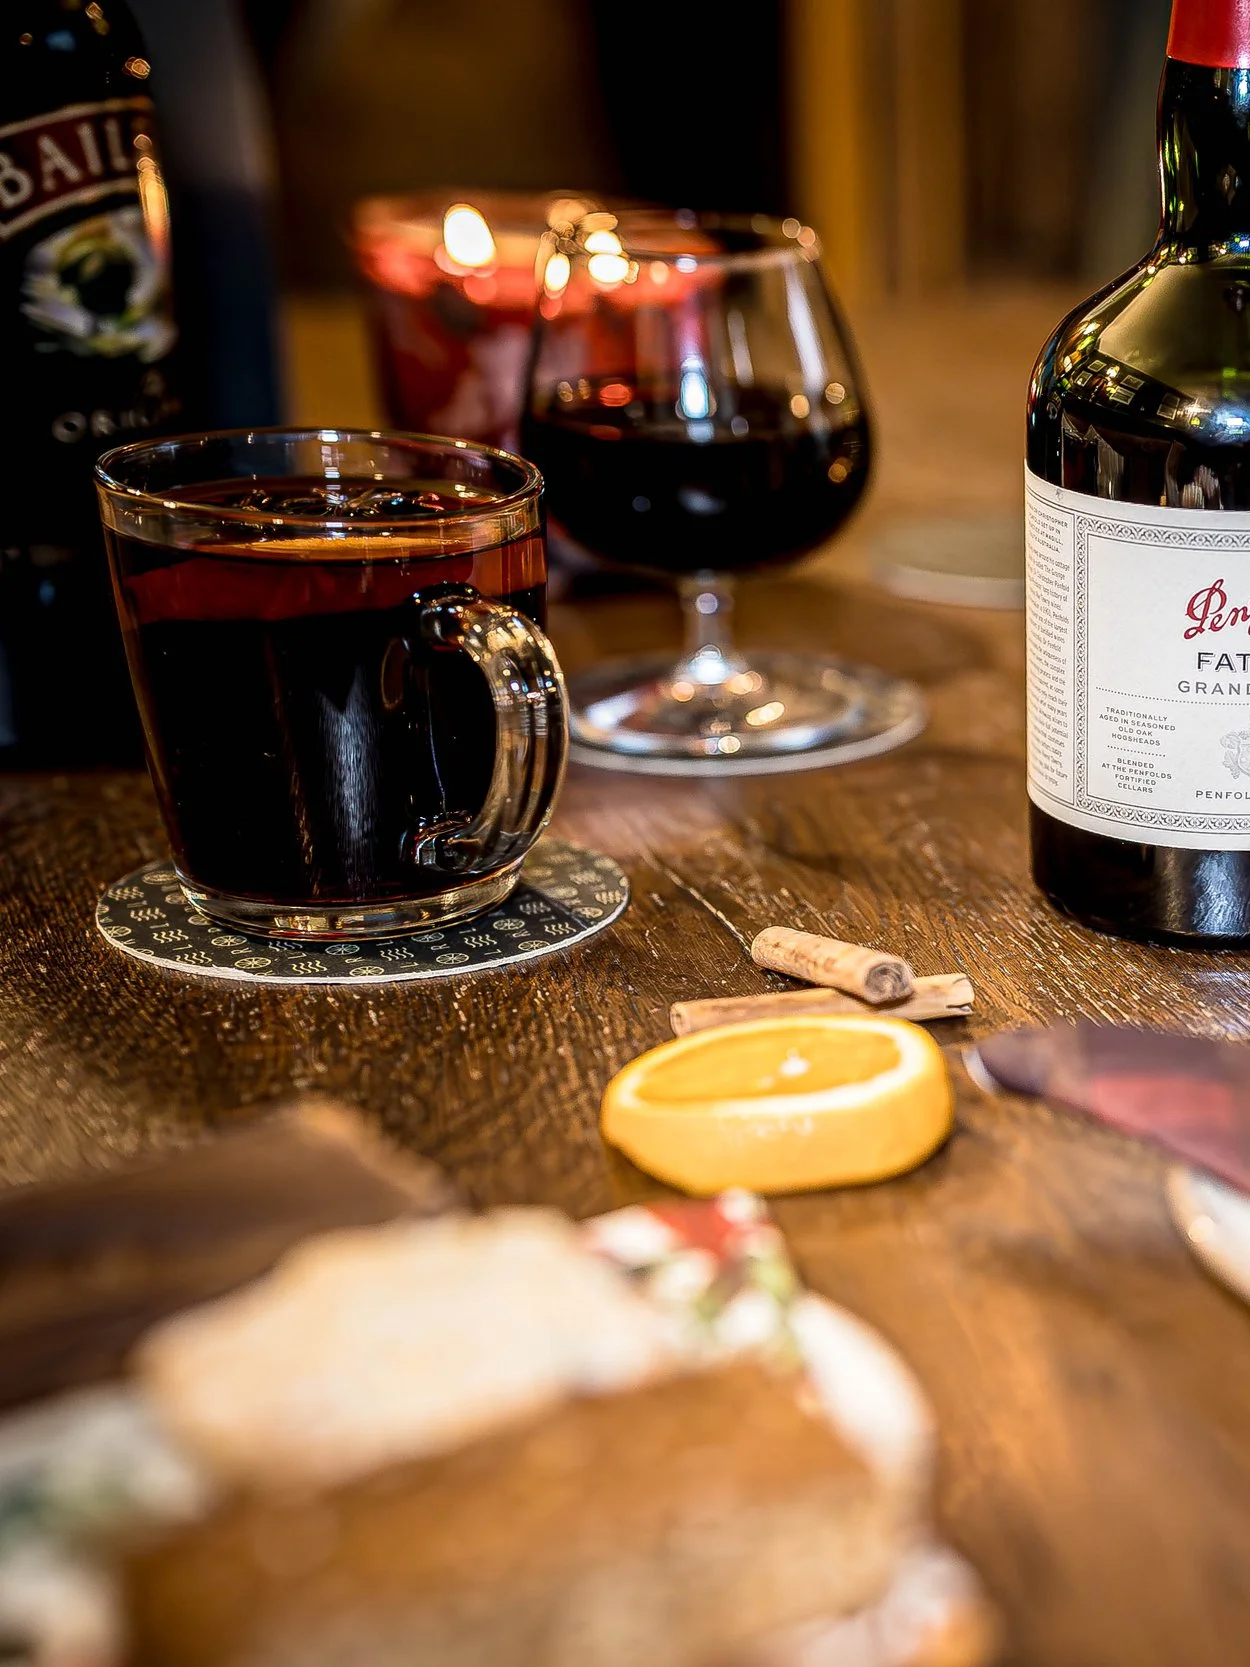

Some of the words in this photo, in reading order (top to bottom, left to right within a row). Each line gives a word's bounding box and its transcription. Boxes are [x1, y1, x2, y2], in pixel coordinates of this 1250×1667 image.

[1038, 510, 1068, 528] CHRISTOPHER
[1105, 706, 1168, 722] TRADITIONALLY
[1099, 713, 1119, 723] AGED
[1131, 719, 1176, 731] SEASONED
[1118, 725, 1134, 734] OLD
[1136, 728, 1153, 737] OAK
[1111, 732, 1161, 747] HOGSHEADS
[1117, 757, 1155, 769] BLENDED
[1112, 764, 1127, 773] THE
[1128, 768, 1172, 780] PENFOLDS
[1115, 773, 1157, 786] FORTIFIED
[1117, 782, 1153, 794] CELLARS
